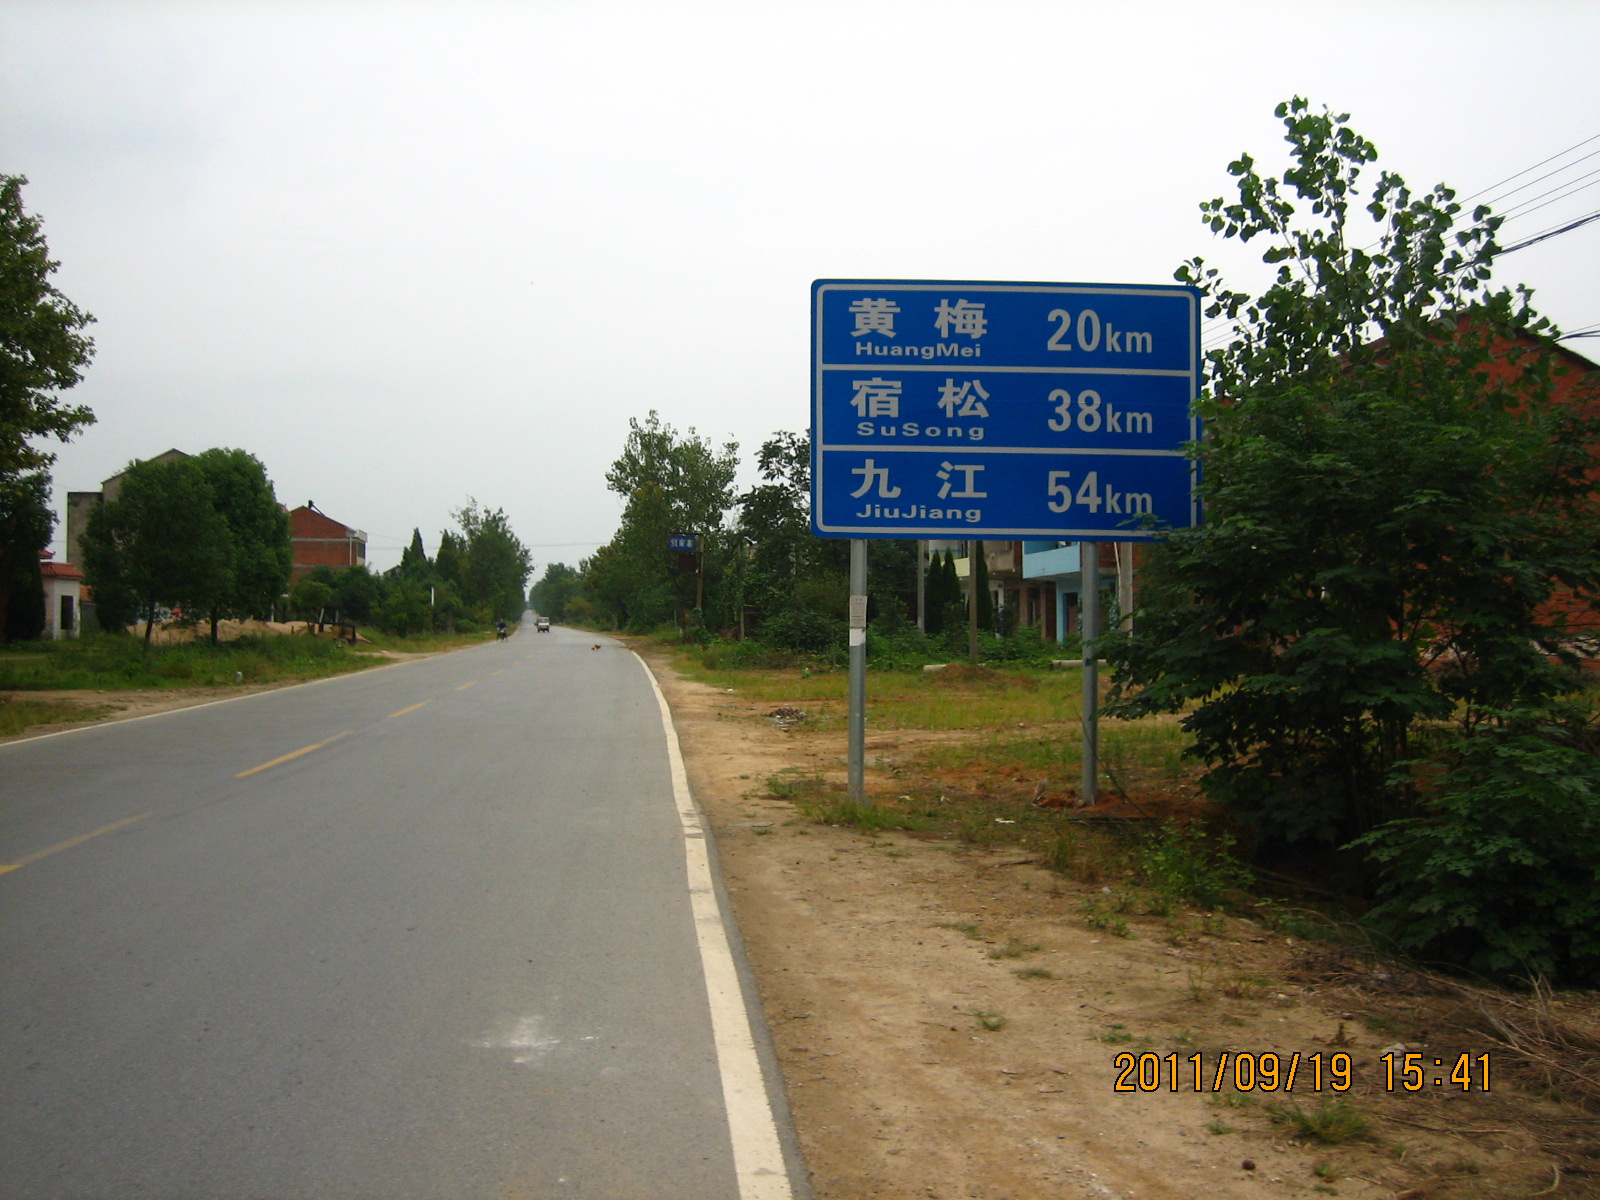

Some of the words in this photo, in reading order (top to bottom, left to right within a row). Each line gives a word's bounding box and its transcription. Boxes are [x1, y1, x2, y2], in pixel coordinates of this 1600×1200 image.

[849, 298, 988, 339] 黄梅
[1047, 309, 1153, 353] 20km
[856, 342, 981, 360] HuangMei
[850, 377, 990, 418] 宿松
[1047, 390, 1153, 433] 38km
[857, 422, 985, 441] SuSong
[851, 459, 988, 499] 九江
[1047, 471, 1153, 514] 54km
[856, 504, 982, 523] JiuJiang
